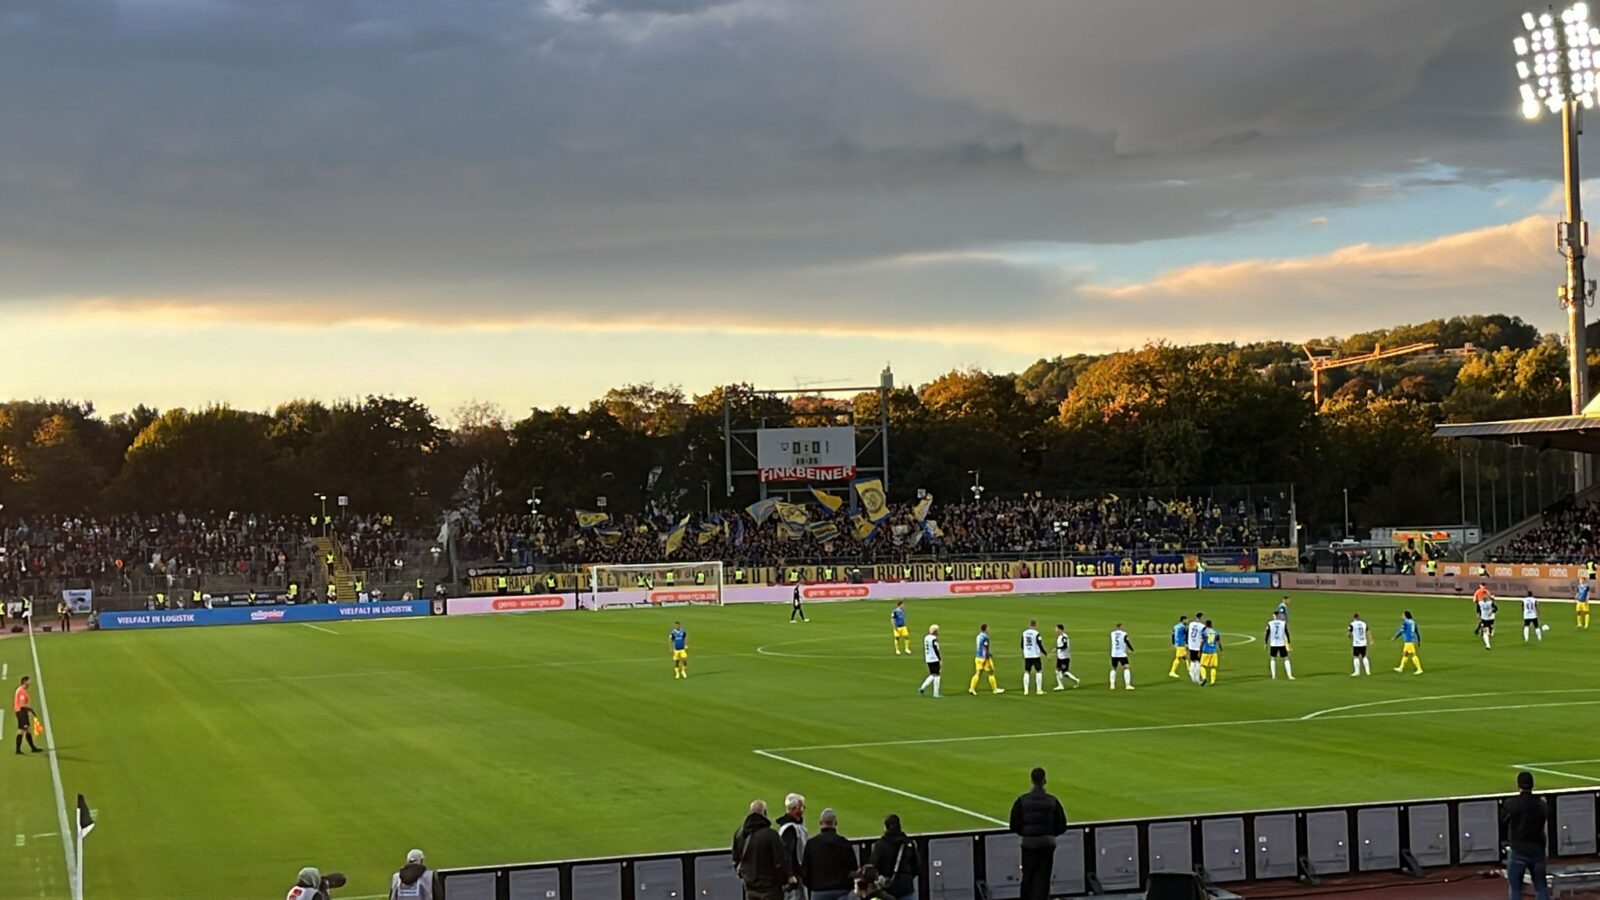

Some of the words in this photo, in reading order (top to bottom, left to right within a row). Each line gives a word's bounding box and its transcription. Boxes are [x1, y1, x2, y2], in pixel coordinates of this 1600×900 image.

[761, 466, 852, 482] FINKBEINER
[339, 607, 370, 615] VIELFALT
[381, 605, 412, 613] LOGISTIK
[117, 616, 150, 624] VIELFALT
[152, 615, 160, 623] IN
[162, 614, 194, 623] LOGISTIK
